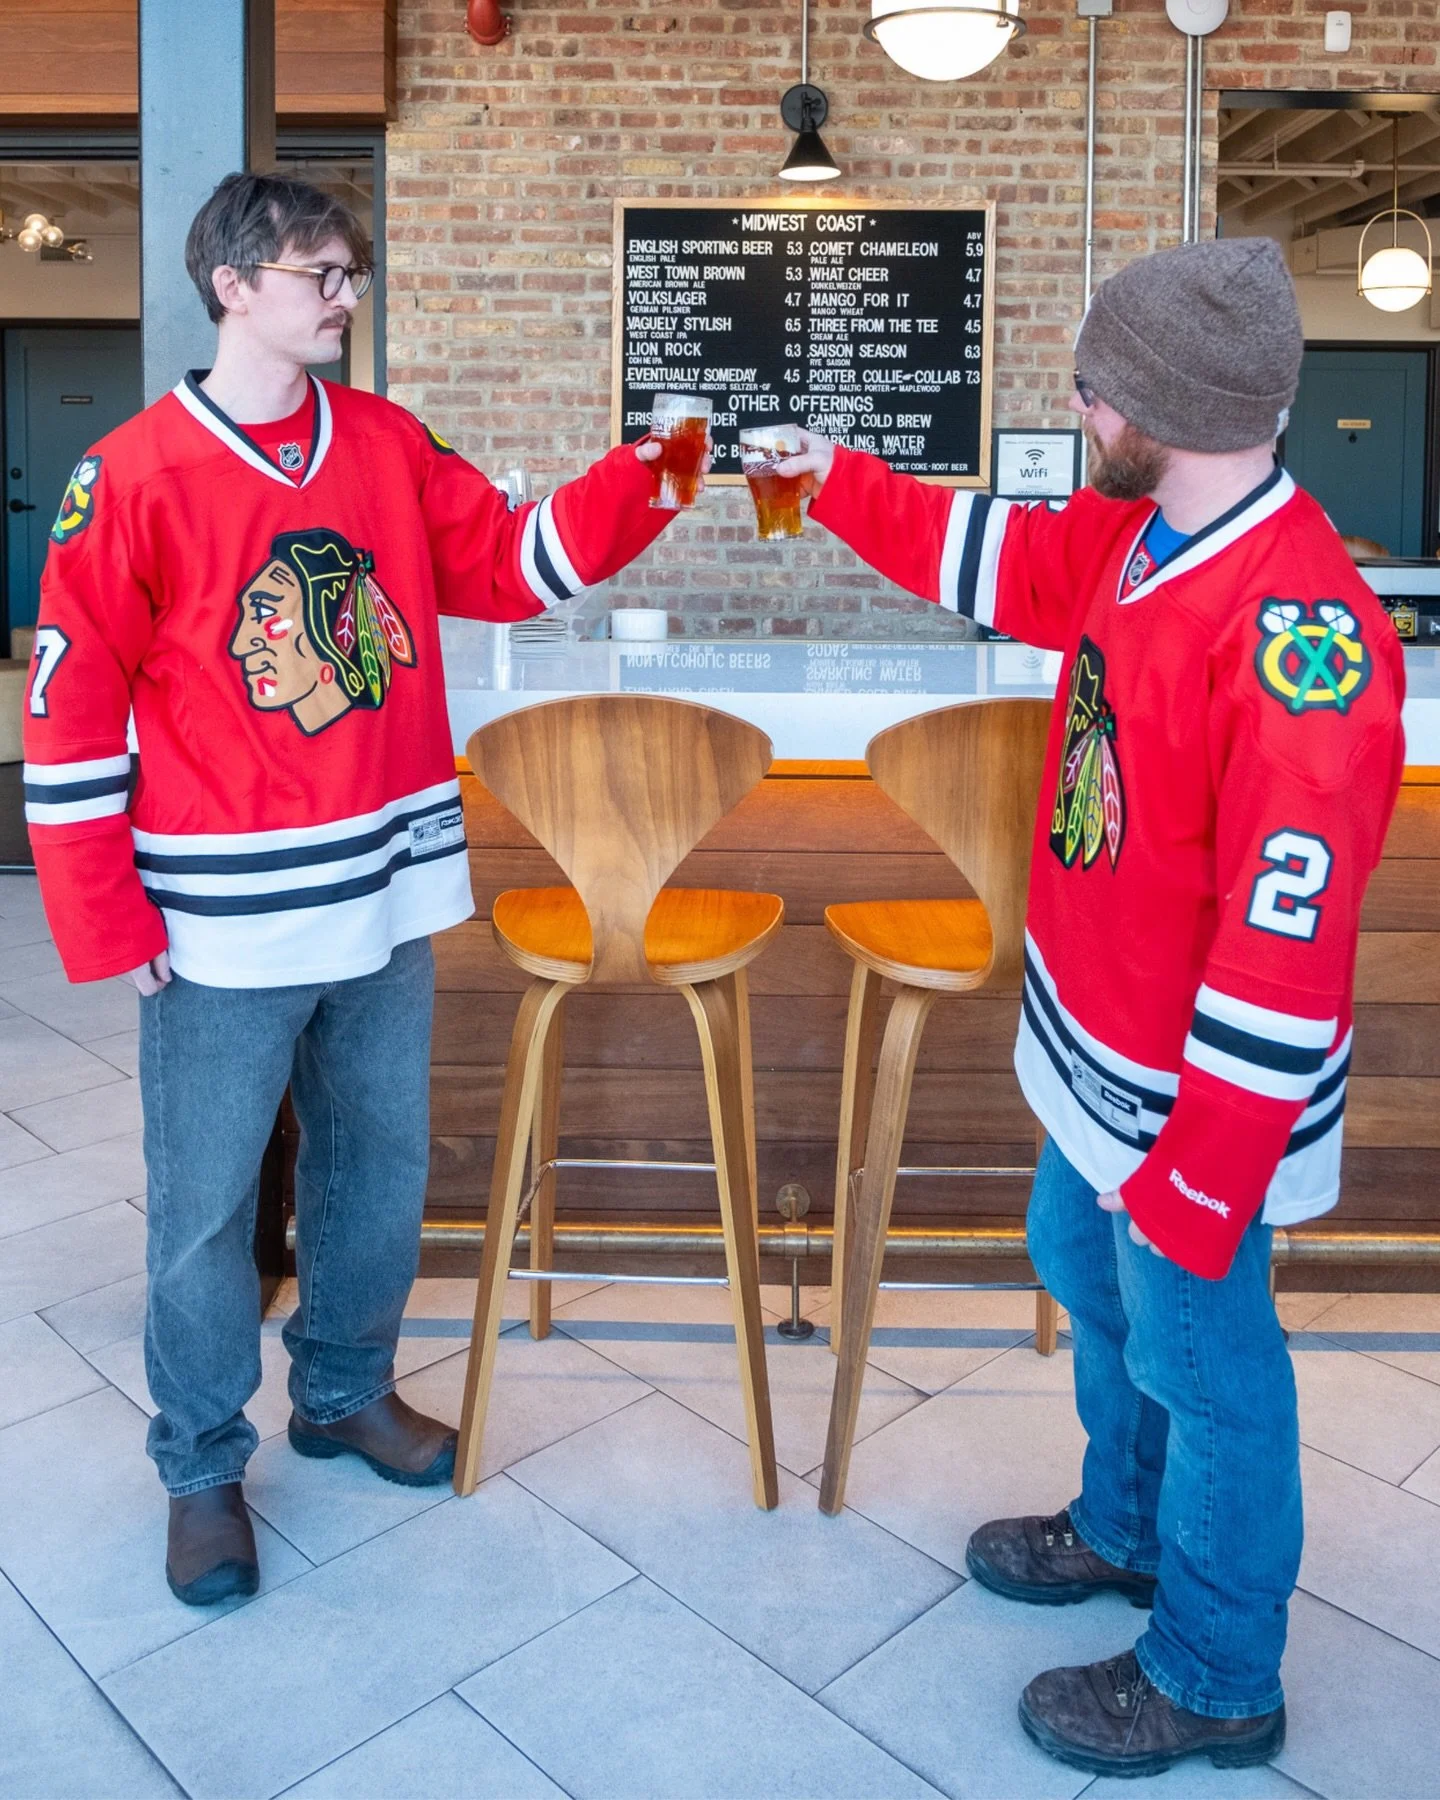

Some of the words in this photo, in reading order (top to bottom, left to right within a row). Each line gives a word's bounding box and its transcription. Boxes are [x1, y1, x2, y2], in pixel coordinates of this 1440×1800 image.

[742, 214, 807, 231] MIDWEST
[816, 214, 865, 232] COAST
[967, 232, 981, 240] ABV
[629, 240, 678, 254] ENGLISH
[682, 240, 738, 255] SPORTING
[742, 241, 773, 255] BEER
[787, 242, 803, 255] 5.3
[810, 242, 854, 256] COMET
[860, 242, 938, 257] CHAMELEON
[965, 243, 983, 257] 5.9
[627, 265, 659, 279] WEST
[665, 266, 698, 280] TOWN
[703, 266, 745, 280] BROWN
[785, 267, 802, 281] 5.3
[810, 267, 844, 281] WHAT
[848, 268, 889, 282] CHEER
[965, 268, 982, 282] 4.7
[629, 280, 662, 288] AMERICAN
[811, 282, 862, 290] DUNKELWEIZEN
[628, 291, 707, 306] VOLKSLAGER
[785, 293, 801, 306] 4.7
[810, 293, 856, 307] MANGO
[864, 293, 889, 307] FOR
[897, 293, 909, 307] IT
[963, 294, 982, 308] 4.7
[630, 306, 658, 314] GERMAN
[662, 306, 691, 314] PILSNER
[811, 308, 836, 316] MANGO
[840, 308, 864, 316] WHEAT
[627, 317, 677, 331] VAGUELY
[684, 317, 732, 331] STYLISH
[785, 318, 801, 332] 6.5
[809, 319, 847, 333] THREE
[851, 319, 884, 333] FROM
[888, 319, 912, 333] THE
[916, 319, 938, 333] TEE
[964, 320, 981, 334] 4.5
[629, 342, 658, 356] LION
[665, 343, 702, 356] ROCK
[785, 344, 801, 357] 6.3
[809, 344, 853, 358] SAISON
[859, 344, 907, 358] SEASON
[964, 345, 981, 359] 6.3
[627, 367, 700, 382] EVENTUALLY
[704, 368, 757, 382] SOMEDAY
[784, 369, 800, 383] 4.5
[809, 369, 856, 383] PORTER
[965, 371, 981, 384] 7.3
[629, 382, 667, 390] STRAWBERRY
[667, 383, 696, 391] PINEAPPLE
[700, 383, 727, 391] HIBISCUS
[729, 383, 758, 391] SELTZER
[809, 384, 836, 392] SMOKED
[839, 384, 861, 392] BALTIC
[899, 385, 941, 393] MAPLEWOOD
[729, 395, 780, 411] OTHER
[789, 395, 874, 413] OFFERINGS
[807, 413, 856, 427] CANNED
[861, 414, 892, 428] COLD
[897, 414, 932, 428] BREW
[809, 426, 826, 434] HIGH
[882, 435, 925, 450] WATER
[882, 448, 897, 456] HOP
[951, 463, 969, 471] BEER
[1020, 468, 1048, 478] Wifi
[1246, 828, 1333, 942] 2
[1169, 1168, 1231, 1219] Reebok
